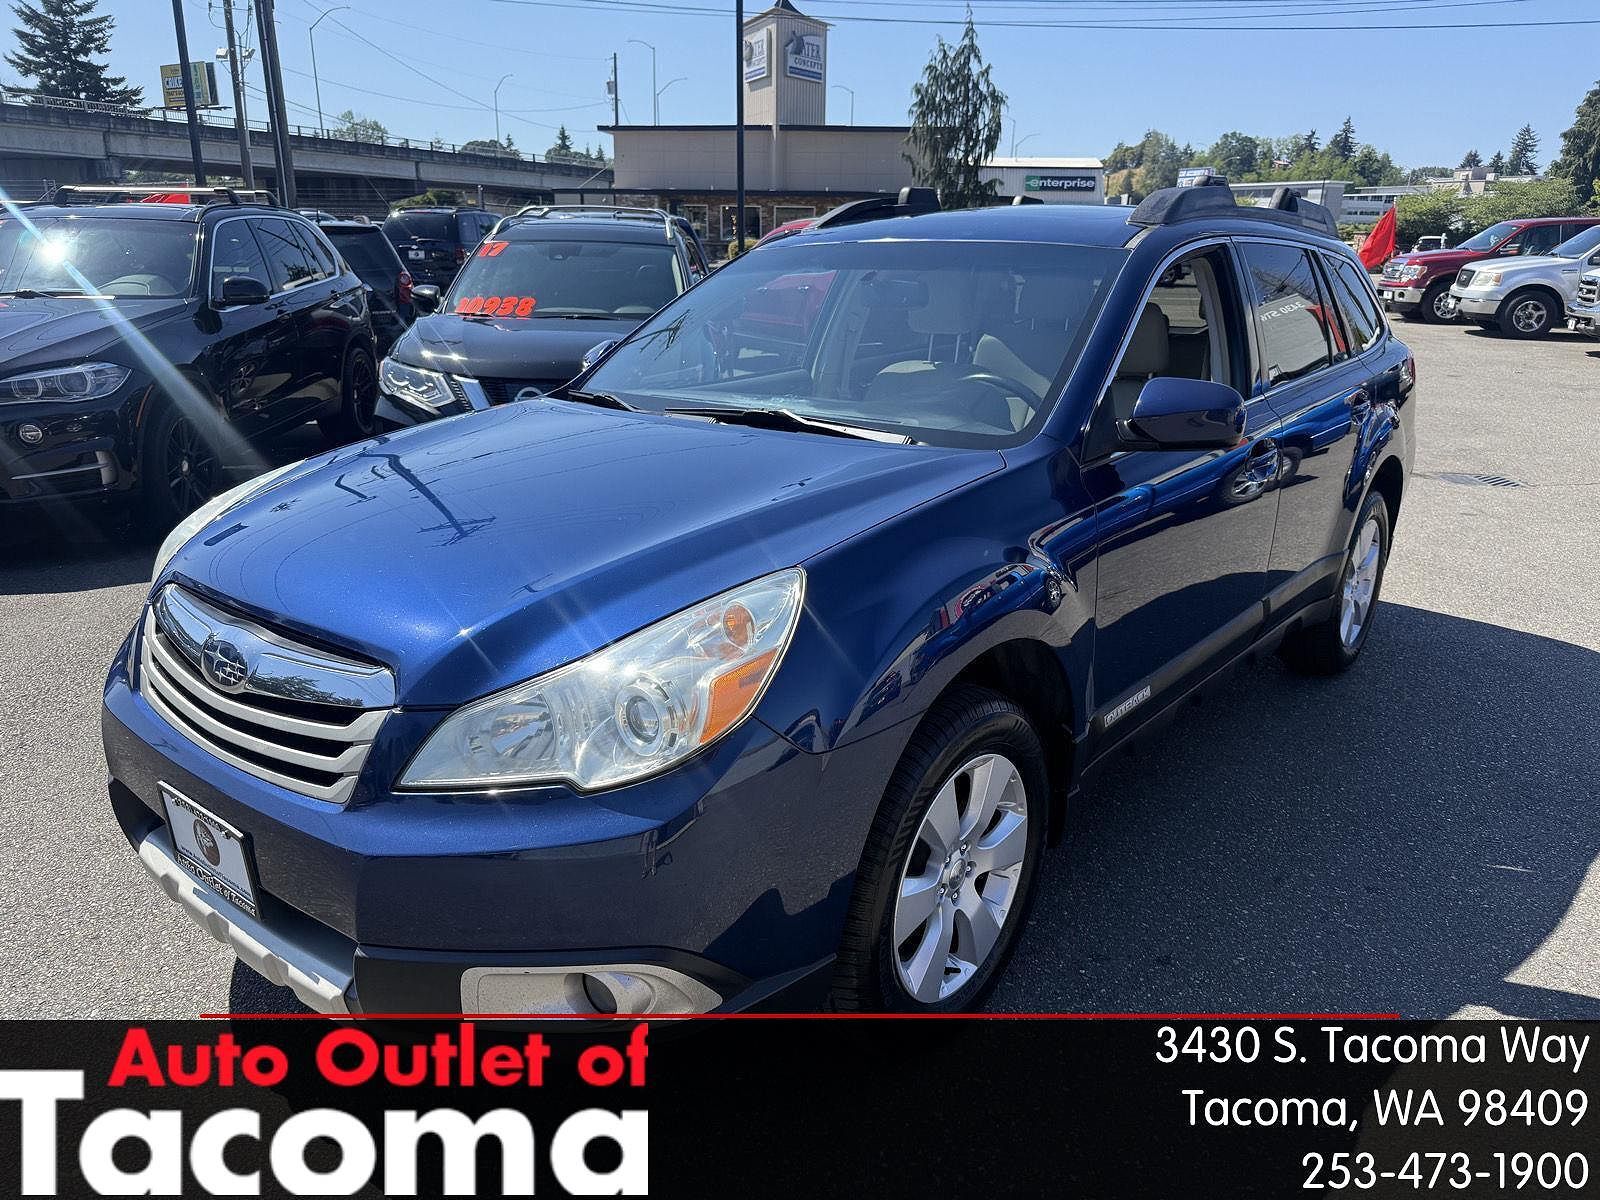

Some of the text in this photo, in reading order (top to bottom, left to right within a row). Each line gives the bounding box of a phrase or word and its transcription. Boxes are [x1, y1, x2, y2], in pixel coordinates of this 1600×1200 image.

[1026, 178, 1095, 189] enterprise
[476, 242, 510, 257] 17
[454, 296, 536, 316] 10938
[1104, 685, 1151, 727] OUTBACK
